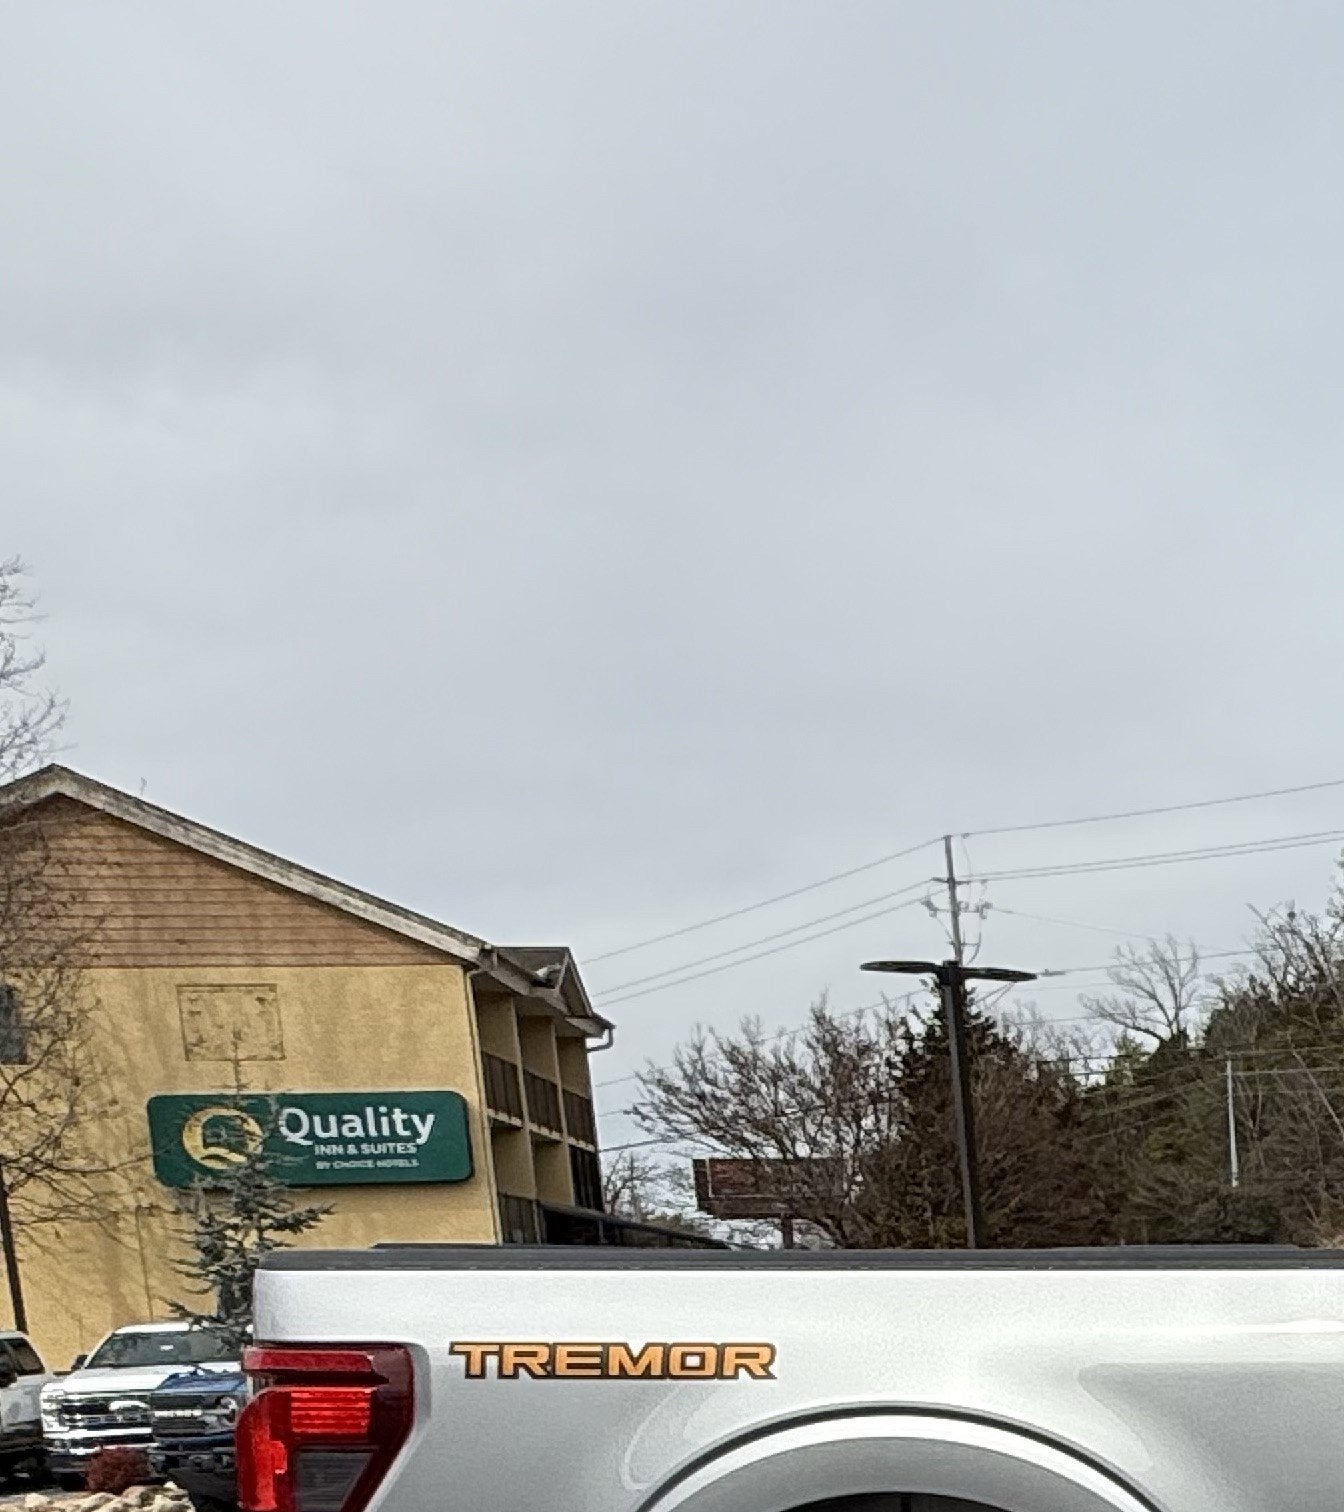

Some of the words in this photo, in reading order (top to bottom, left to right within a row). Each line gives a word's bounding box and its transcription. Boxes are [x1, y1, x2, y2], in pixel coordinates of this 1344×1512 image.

[279, 1106, 436, 1146] Quality
[315, 1144, 344, 1156] INN
[347, 1144, 359, 1155] &
[361, 1143, 417, 1154] SUITES
[449, 1342, 777, 1379] TREMOR
